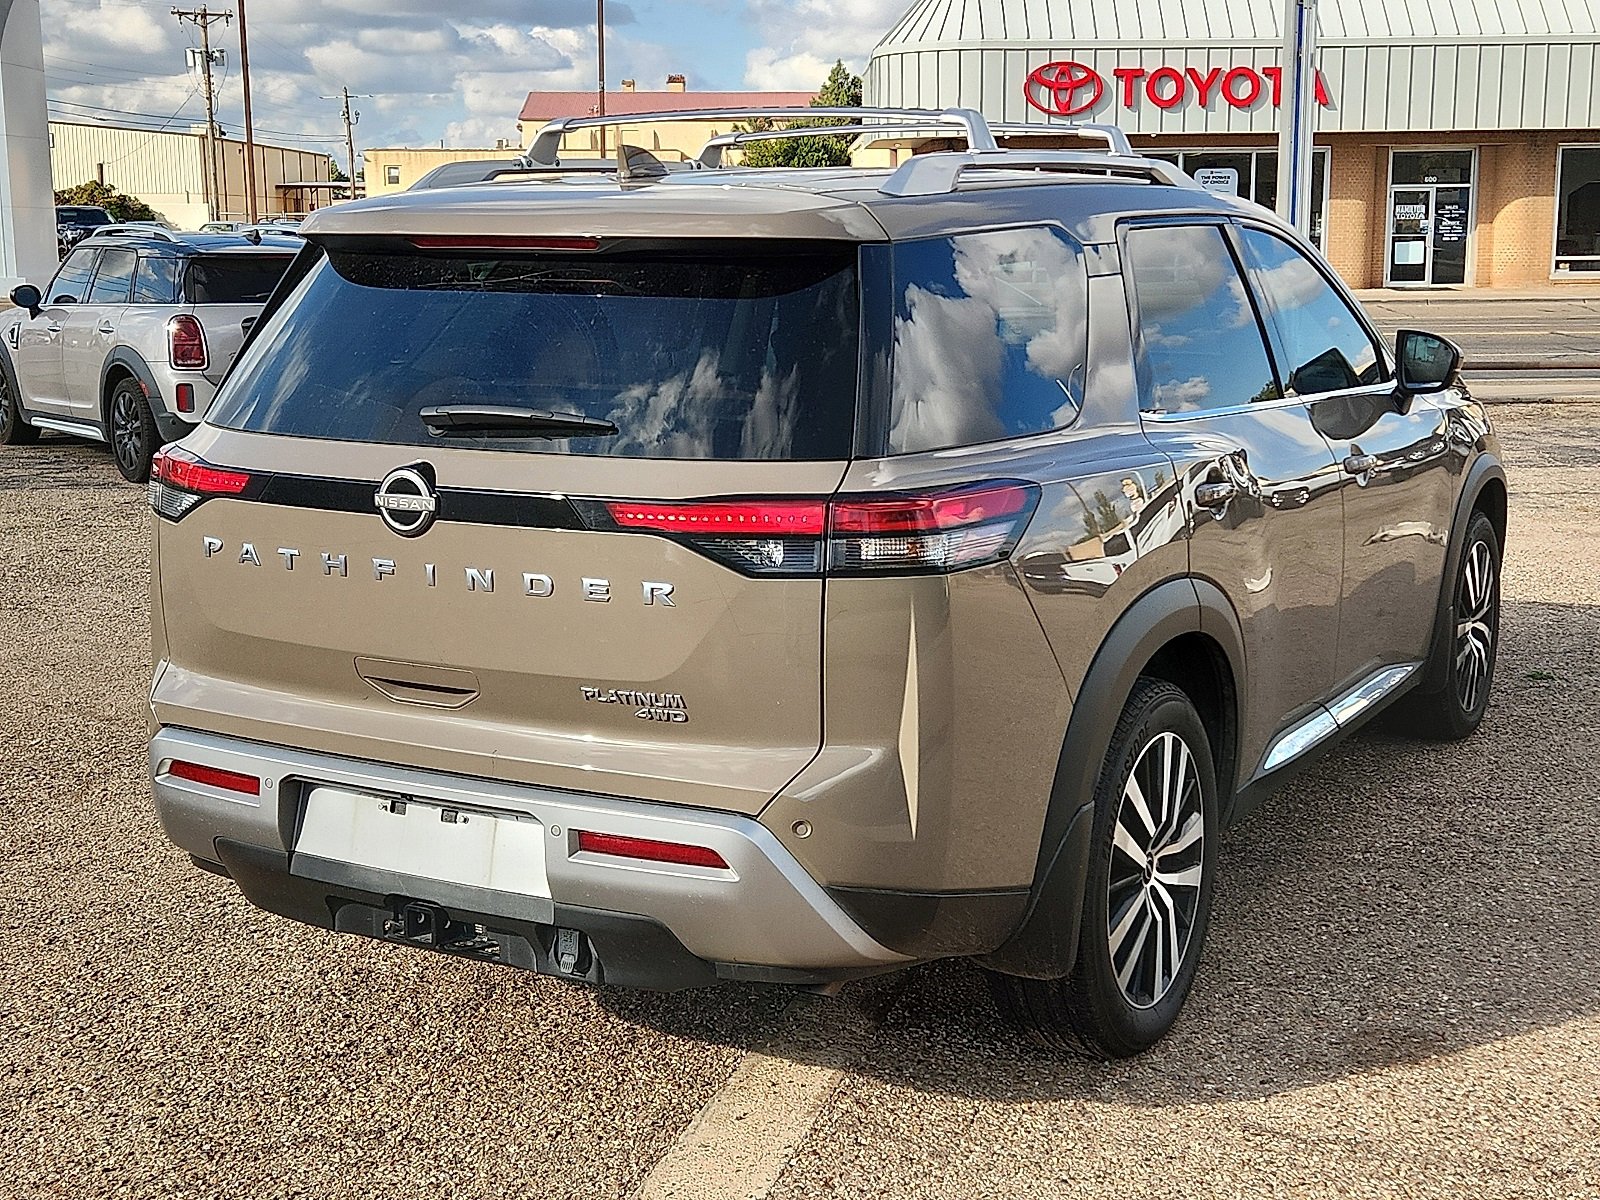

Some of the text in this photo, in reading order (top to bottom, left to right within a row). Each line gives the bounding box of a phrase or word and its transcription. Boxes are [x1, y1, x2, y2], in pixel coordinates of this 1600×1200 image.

[375, 495, 434, 511] NISSAN
[202, 535, 676, 607] PATHFINDER
[580, 686, 687, 709] PLATINUM
[634, 708, 688, 723] 4WD
